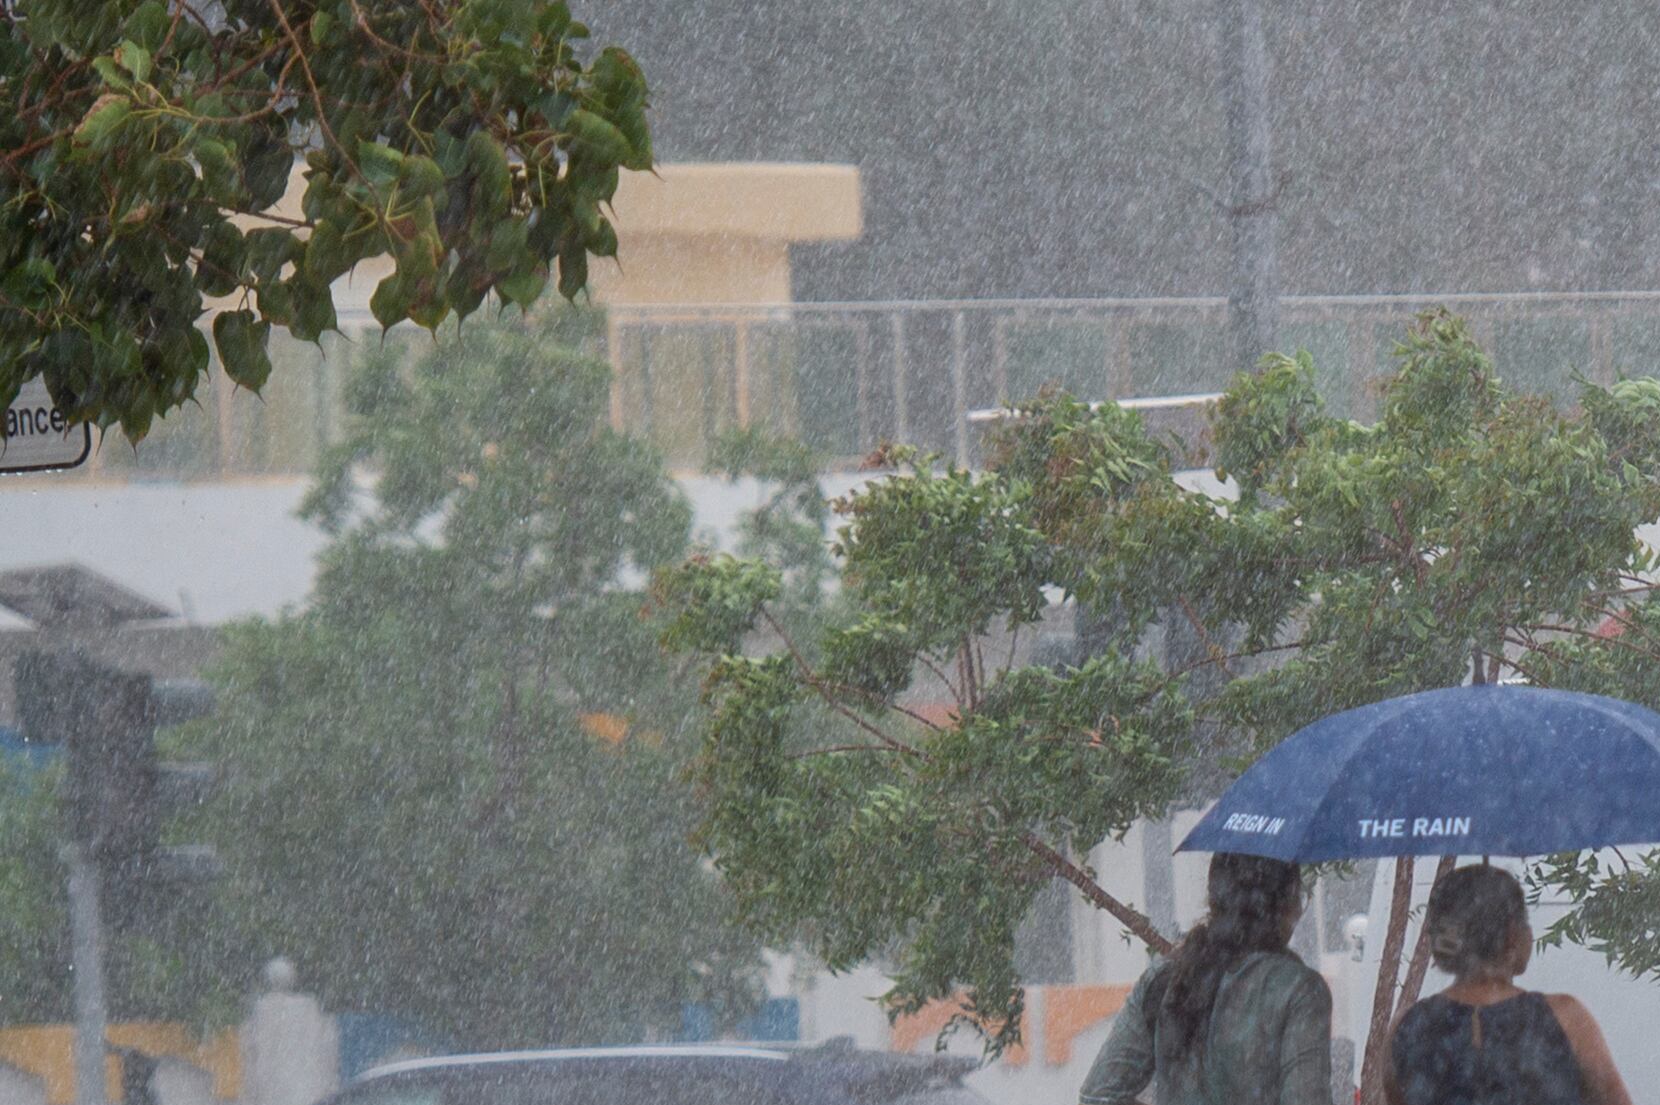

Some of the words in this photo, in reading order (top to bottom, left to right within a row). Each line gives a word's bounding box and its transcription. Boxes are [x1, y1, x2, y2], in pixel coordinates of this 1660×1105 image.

[5, 406, 65, 437] ance
[1222, 812, 1270, 833] REIGN
[1264, 816, 1286, 835] IN
[1358, 818, 1406, 838] THE
[1412, 817, 1471, 837] RAIN
